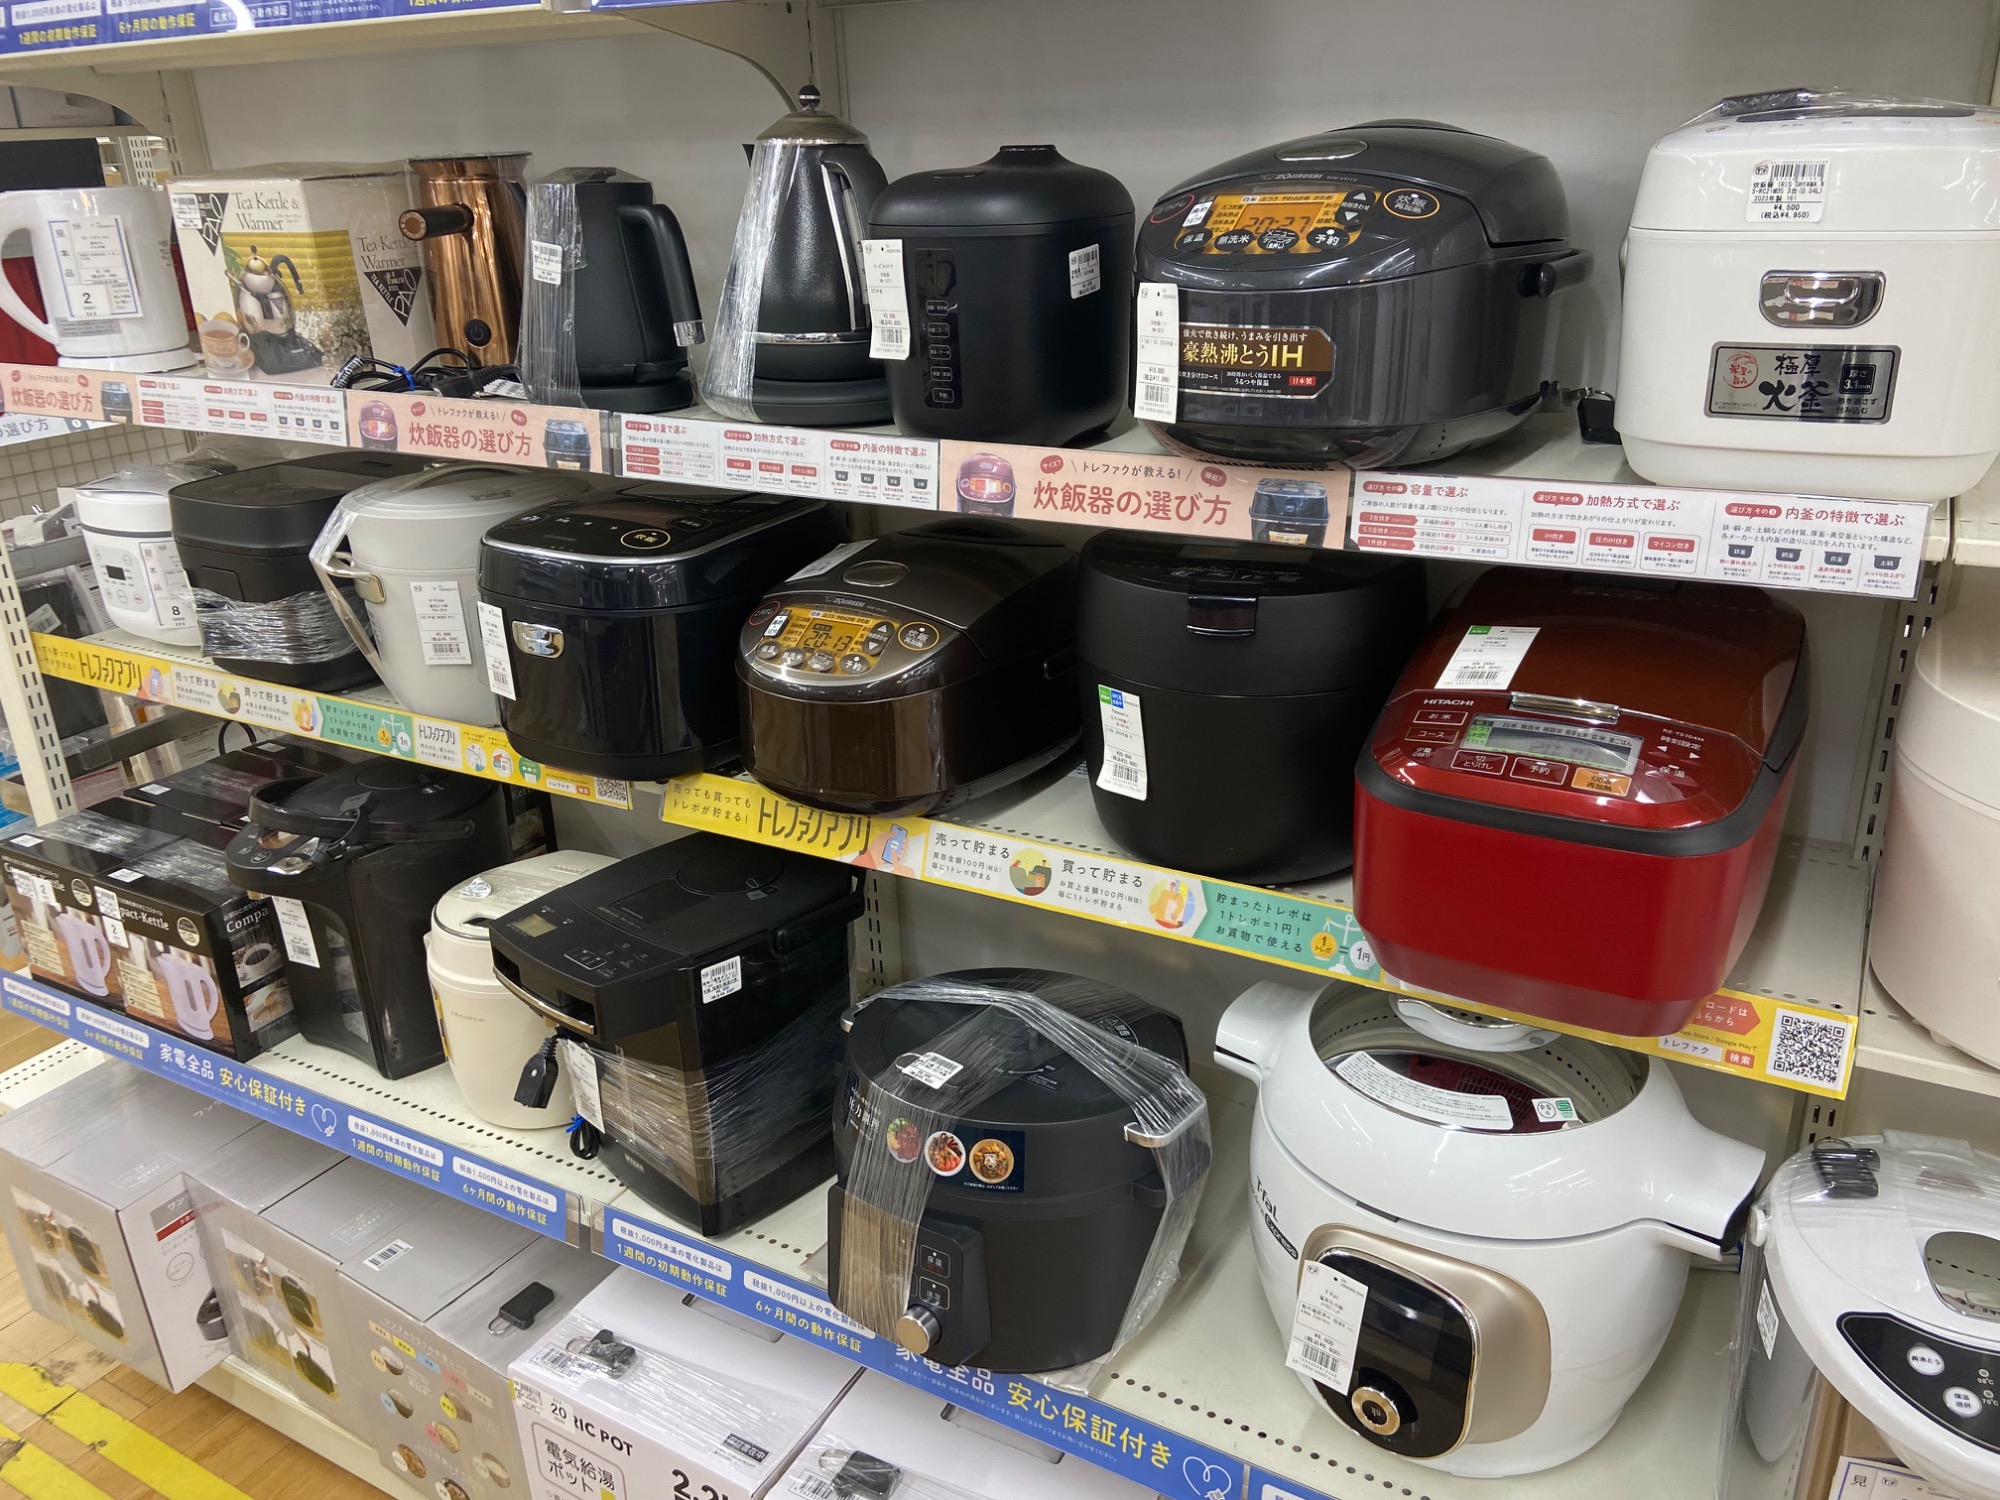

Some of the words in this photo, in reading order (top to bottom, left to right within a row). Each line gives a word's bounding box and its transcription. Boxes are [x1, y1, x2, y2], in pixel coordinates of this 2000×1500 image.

[232, 192, 253, 210] Tea
[256, 191, 289, 210] Kettle
[289, 198, 300, 210] &
[235, 213, 284, 231] Warmer
[1760, 211, 1810, 220] (税込¥4,950)
[357, 236, 379, 253] Tea
[1183, 232, 1206, 244] 保温
[1217, 233, 1250, 245] 無洗米
[1315, 233, 1340, 246] 予約
[1183, 340, 1304, 369] 豪熱沸とうIH
[1775, 353, 1822, 377] 極厚
[1849, 369, 1868, 379] 厚さ
[1292, 376, 1313, 385] 日本製
[1843, 379, 1871, 390] 3.1mm
[11, 388, 94, 413] 炊飯器の選び方
[1758, 379, 1834, 414] 火釜
[1836, 406, 1868, 415] 包み込む
[653, 423, 688, 435] 容量で選ぶ
[408, 423, 533, 457] 炊飯器の選び方
[753, 432, 807, 447] 加熱方式で選ぶ
[862, 443, 928, 458] 内釜の特徴で選ぶ
[1082, 460, 1182, 480] トレファクが教える!
[1410, 484, 1469, 498] 容量で選ぶ
[1033, 479, 1233, 526] 炊飯器の選び方
[1586, 495, 1681, 511] 加熱方式で選ぶ
[1730, 506, 1753, 516] 選び方
[1786, 506, 1905, 527] 内釜の特徴で選ぶ
[1594, 536, 1628, 546] 圧力IH炊き
[1653, 540, 1690, 550] マイコン炊き
[171, 605, 181, 616] 8
[78, 651, 144, 690] トレファクアプリ
[845, 660, 863, 672] 予約
[175, 671, 217, 689] 売って貯まる
[244, 685, 289, 705] 買って貯まる
[1423, 698, 1475, 706] HITACHI
[418, 724, 459, 745] トレファクアプリ
[1418, 730, 1445, 738] コース
[1591, 733, 1606, 742] 玄米
[1660, 735, 1702, 751] 時刻設定
[1463, 760, 1494, 770] とりけし
[1529, 765, 1551, 775] 予約
[672, 783, 751, 810] 売っても買っても
[672, 797, 749, 825] トレポが貯まる!
[758, 796, 872, 856] トレファクアプリ
[935, 831, 1011, 860] 売って貯まる
[1061, 859, 1144, 888] 買って貯まる
[931, 861, 992, 882] 毎に1トレポ貯まる
[1058, 890, 1123, 912] 毎に1トレポ貯まる
[1216, 892, 1313, 923] 貯まったトレポは
[110, 924, 118, 935] 2
[1215, 925, 1303, 954] お買物で使える
[1356, 946, 1371, 964] 1円
[1663, 1036, 1709, 1055] トレファク
[1728, 1051, 1751, 1065] 検索
[159, 1043, 215, 1081] 家電全品
[219, 1066, 307, 1117] 安心保証付き
[351, 1138, 441, 1183] 1週間の初期動作保証
[459, 1163, 550, 1206] 税抜1,000円以上の電化製品は
[462, 1183, 548, 1226] 6ヶ月間の動作保証
[620, 1225, 723, 1273] 税抜1,000円未満の電化製品は
[616, 1243, 728, 1299] 1週間の初期動作保証
[755, 1299, 863, 1354] 6ヶ月間の動作保証
[550, 1402, 568, 1420] 20
[1007, 1381, 1173, 1469] 安心保証付き
[600, 1432, 634, 1457] POT
[544, 1438, 616, 1491] 電気給湯
[548, 1459, 595, 1494] ポット
[1850, 1474, 1867, 1488] 見
